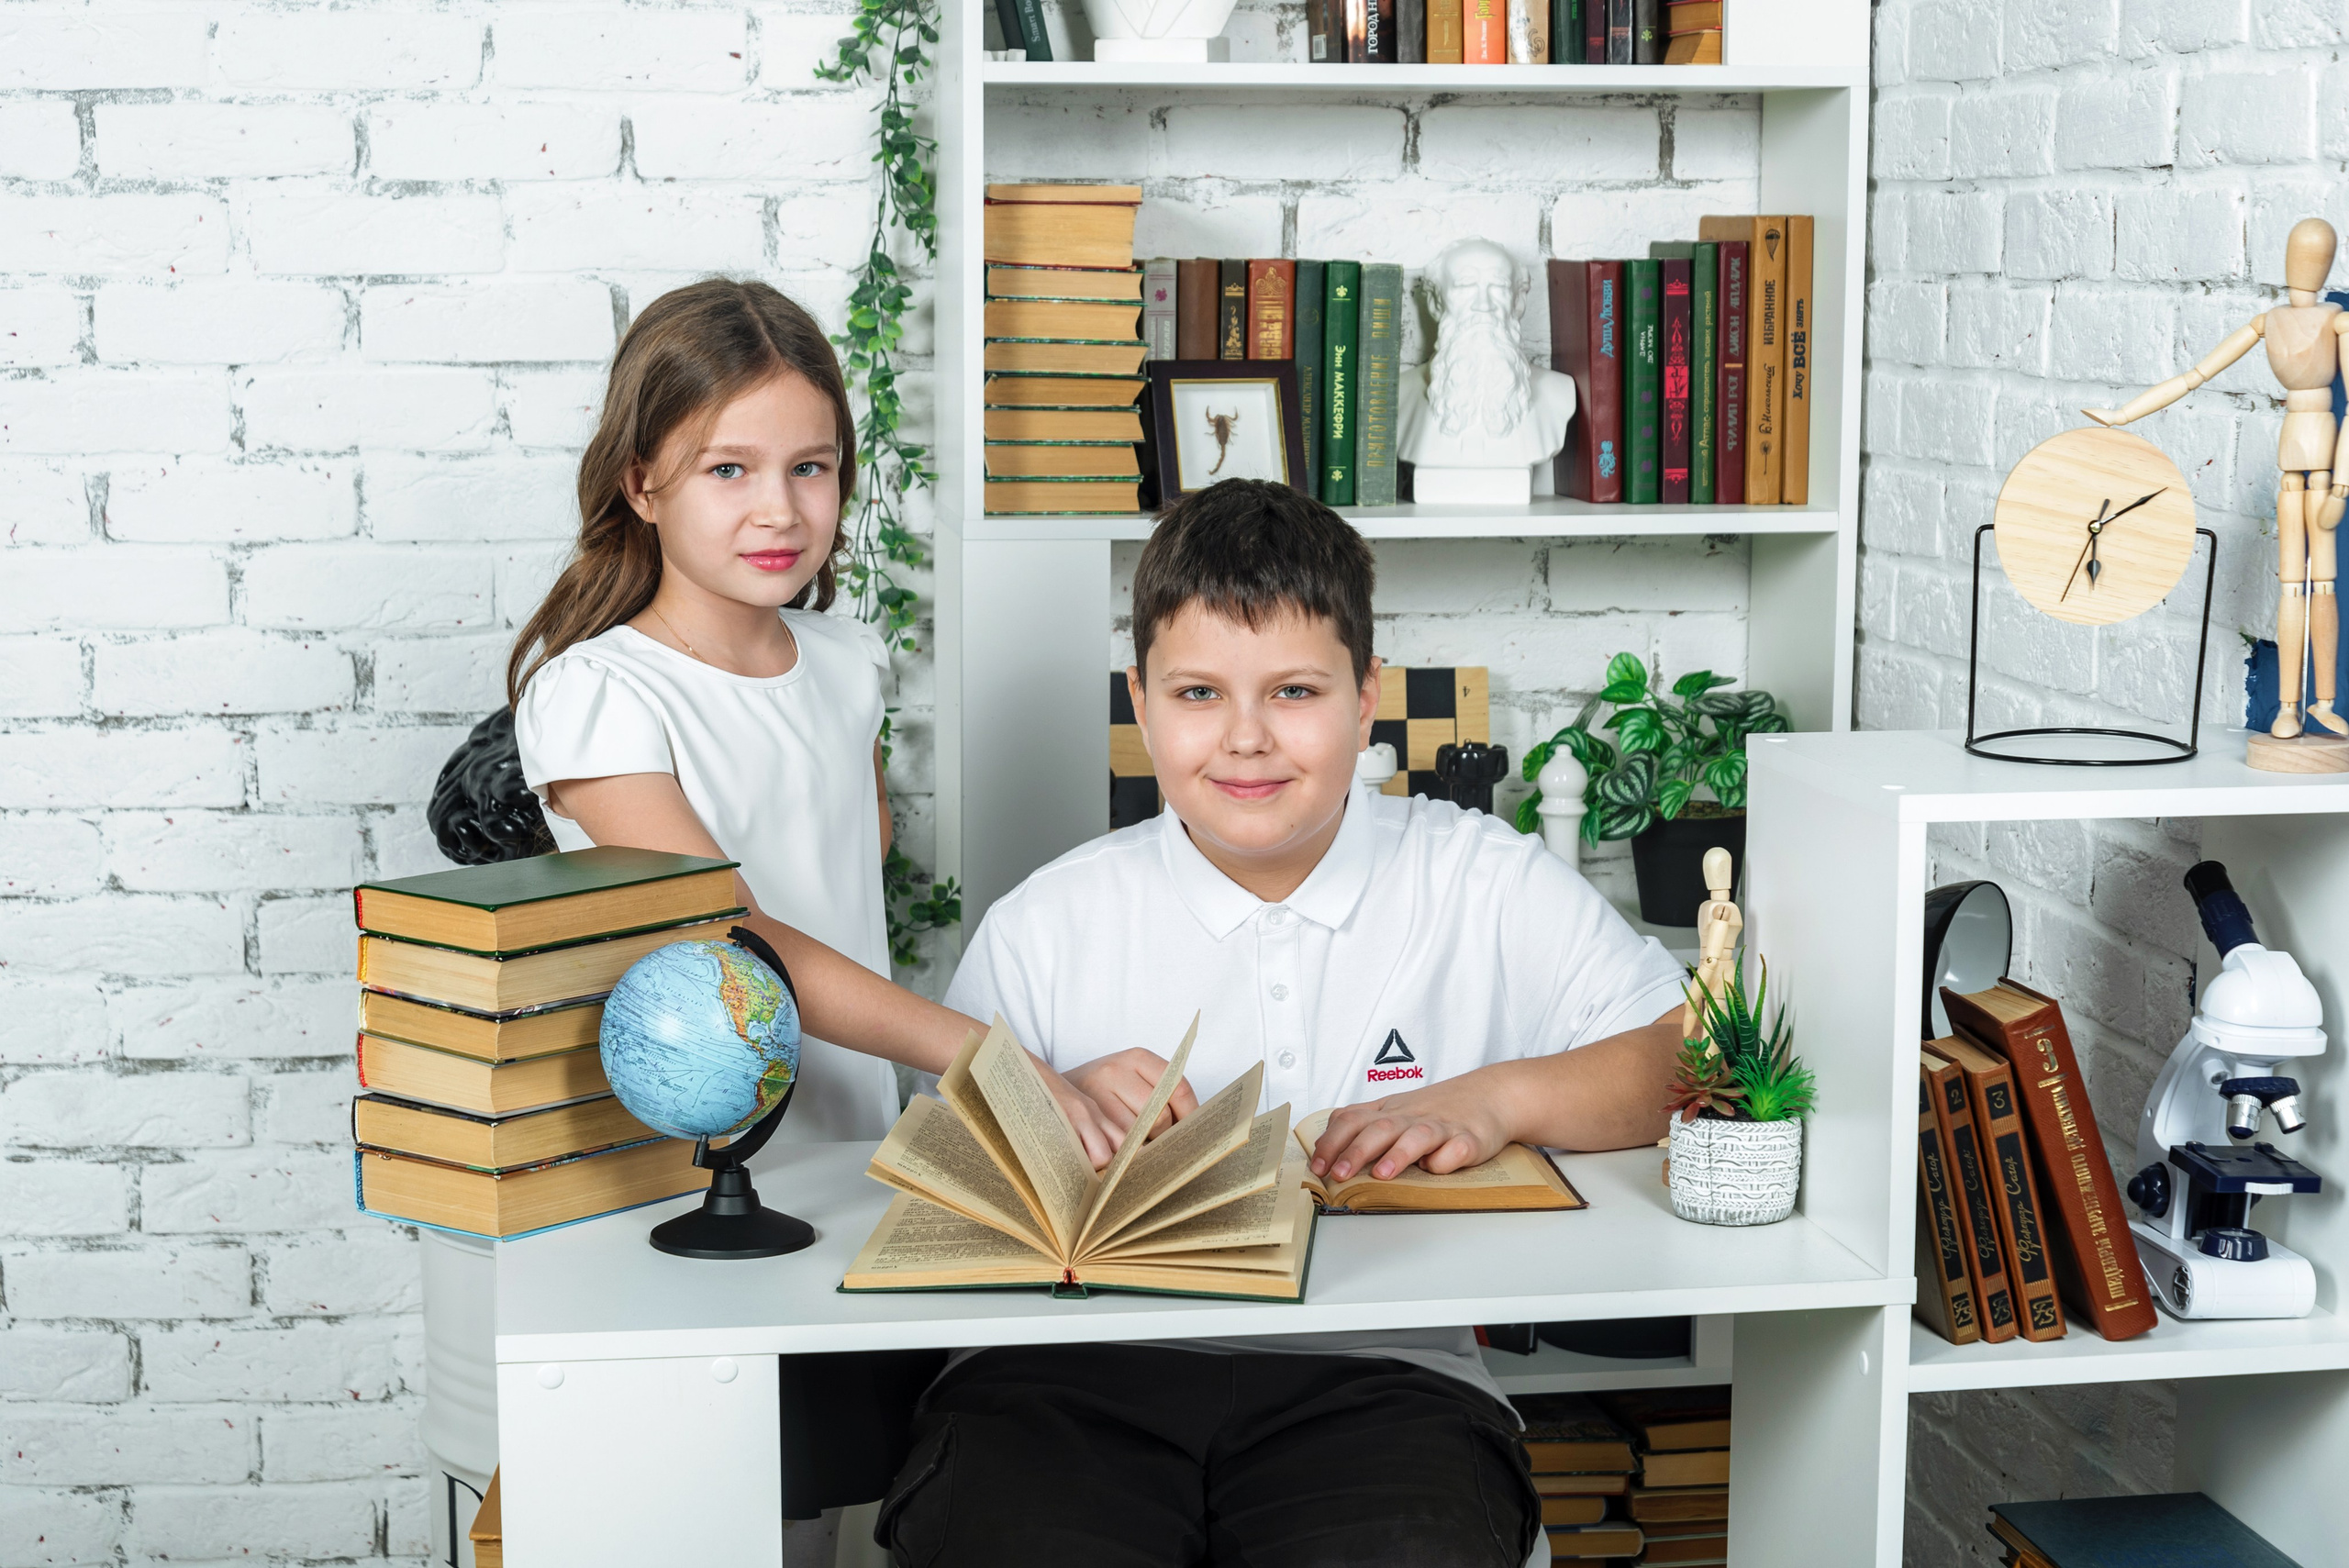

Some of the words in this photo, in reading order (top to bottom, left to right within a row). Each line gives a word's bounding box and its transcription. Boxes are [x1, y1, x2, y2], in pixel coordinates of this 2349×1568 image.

[1367, 13, 1380, 54] ГОРОД
[1372, 298, 1391, 339] ПИЩИ
[1764, 279, 1776, 345] ИЗБРАННОЕ
[1795, 298, 1805, 328] знать
[1730, 316, 1741, 356] ДЖОН
[1790, 331, 1806, 369] ВСЁ
[1334, 345, 1346, 369] Энн
[1332, 371, 1346, 439] МАККЕФРИ
[1792, 371, 1804, 400] Хочу
[1366, 354, 1390, 467] ПРИГОТОВЛЕНИЕ
[1727, 404, 1739, 451] ФИЛИП
[1367, 1065, 1424, 1083] Reebok
[2037, 1038, 2059, 1073] 3
[1951, 1089, 1962, 1105] 2
[1993, 1092, 2006, 1109] 3
[2071, 1152, 2108, 1236] ЗАРУБЕЖНОГО
[2096, 1238, 2124, 1299] ШЕДЕВРЫ
